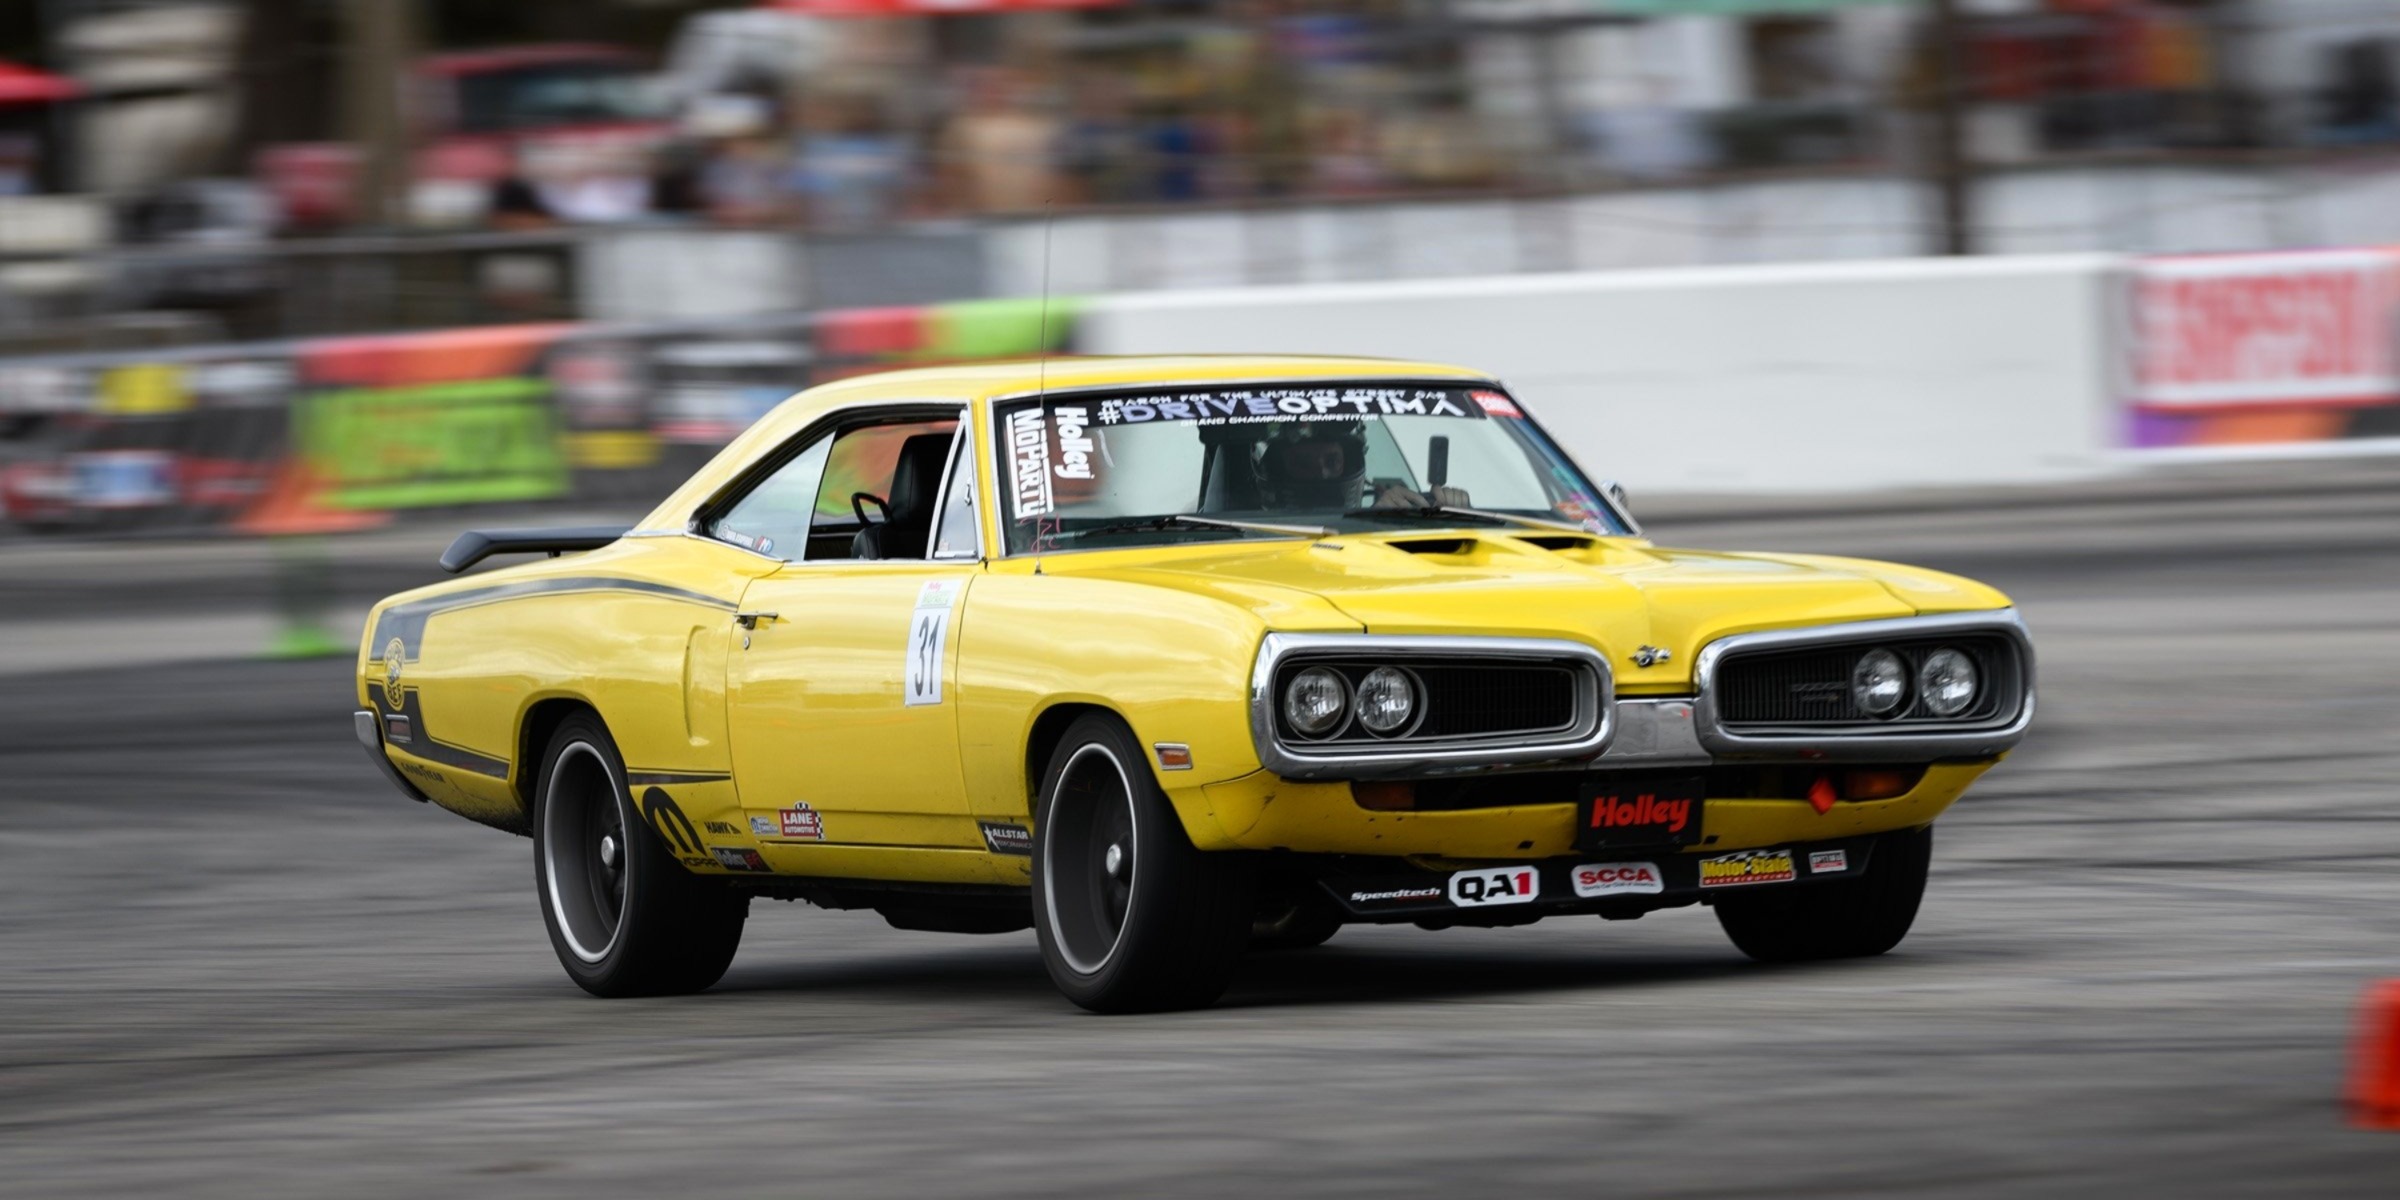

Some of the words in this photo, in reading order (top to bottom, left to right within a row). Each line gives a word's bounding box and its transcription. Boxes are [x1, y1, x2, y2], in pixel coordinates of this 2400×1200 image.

[1101, 396, 1171, 407] SEARCH
[1180, 393, 1210, 403] FOR
[1220, 391, 1253, 400] THE
[1260, 389, 1337, 399] ULTIMATE
[1345, 389, 1405, 399] STREET
[1415, 391, 1447, 400] CAR
[1097, 396, 1466, 425] #DRIVEOPTIMA
[1180, 417, 1225, 427] GRAND
[1229, 415, 1296, 425] CHAMPION
[1299, 413, 1378, 422] COMPETITOR
[1054, 407, 1094, 479] Holley
[914, 614, 941, 697] 31
[783, 812, 813, 825] LANE
[1591, 794, 1691, 833] Holley
[704, 821, 731, 834] HAWK
[785, 825, 816, 834] AUTOMOTIVE
[992, 828, 1029, 840] ALLSTAR
[712, 849, 752, 870] Holley
[1702, 860, 1747, 877] Motor
[1751, 856, 1792, 875] State
[1579, 867, 1655, 885] SCCA
[1351, 887, 1441, 902] Speedtech
[1457, 872, 1532, 902] QA1
